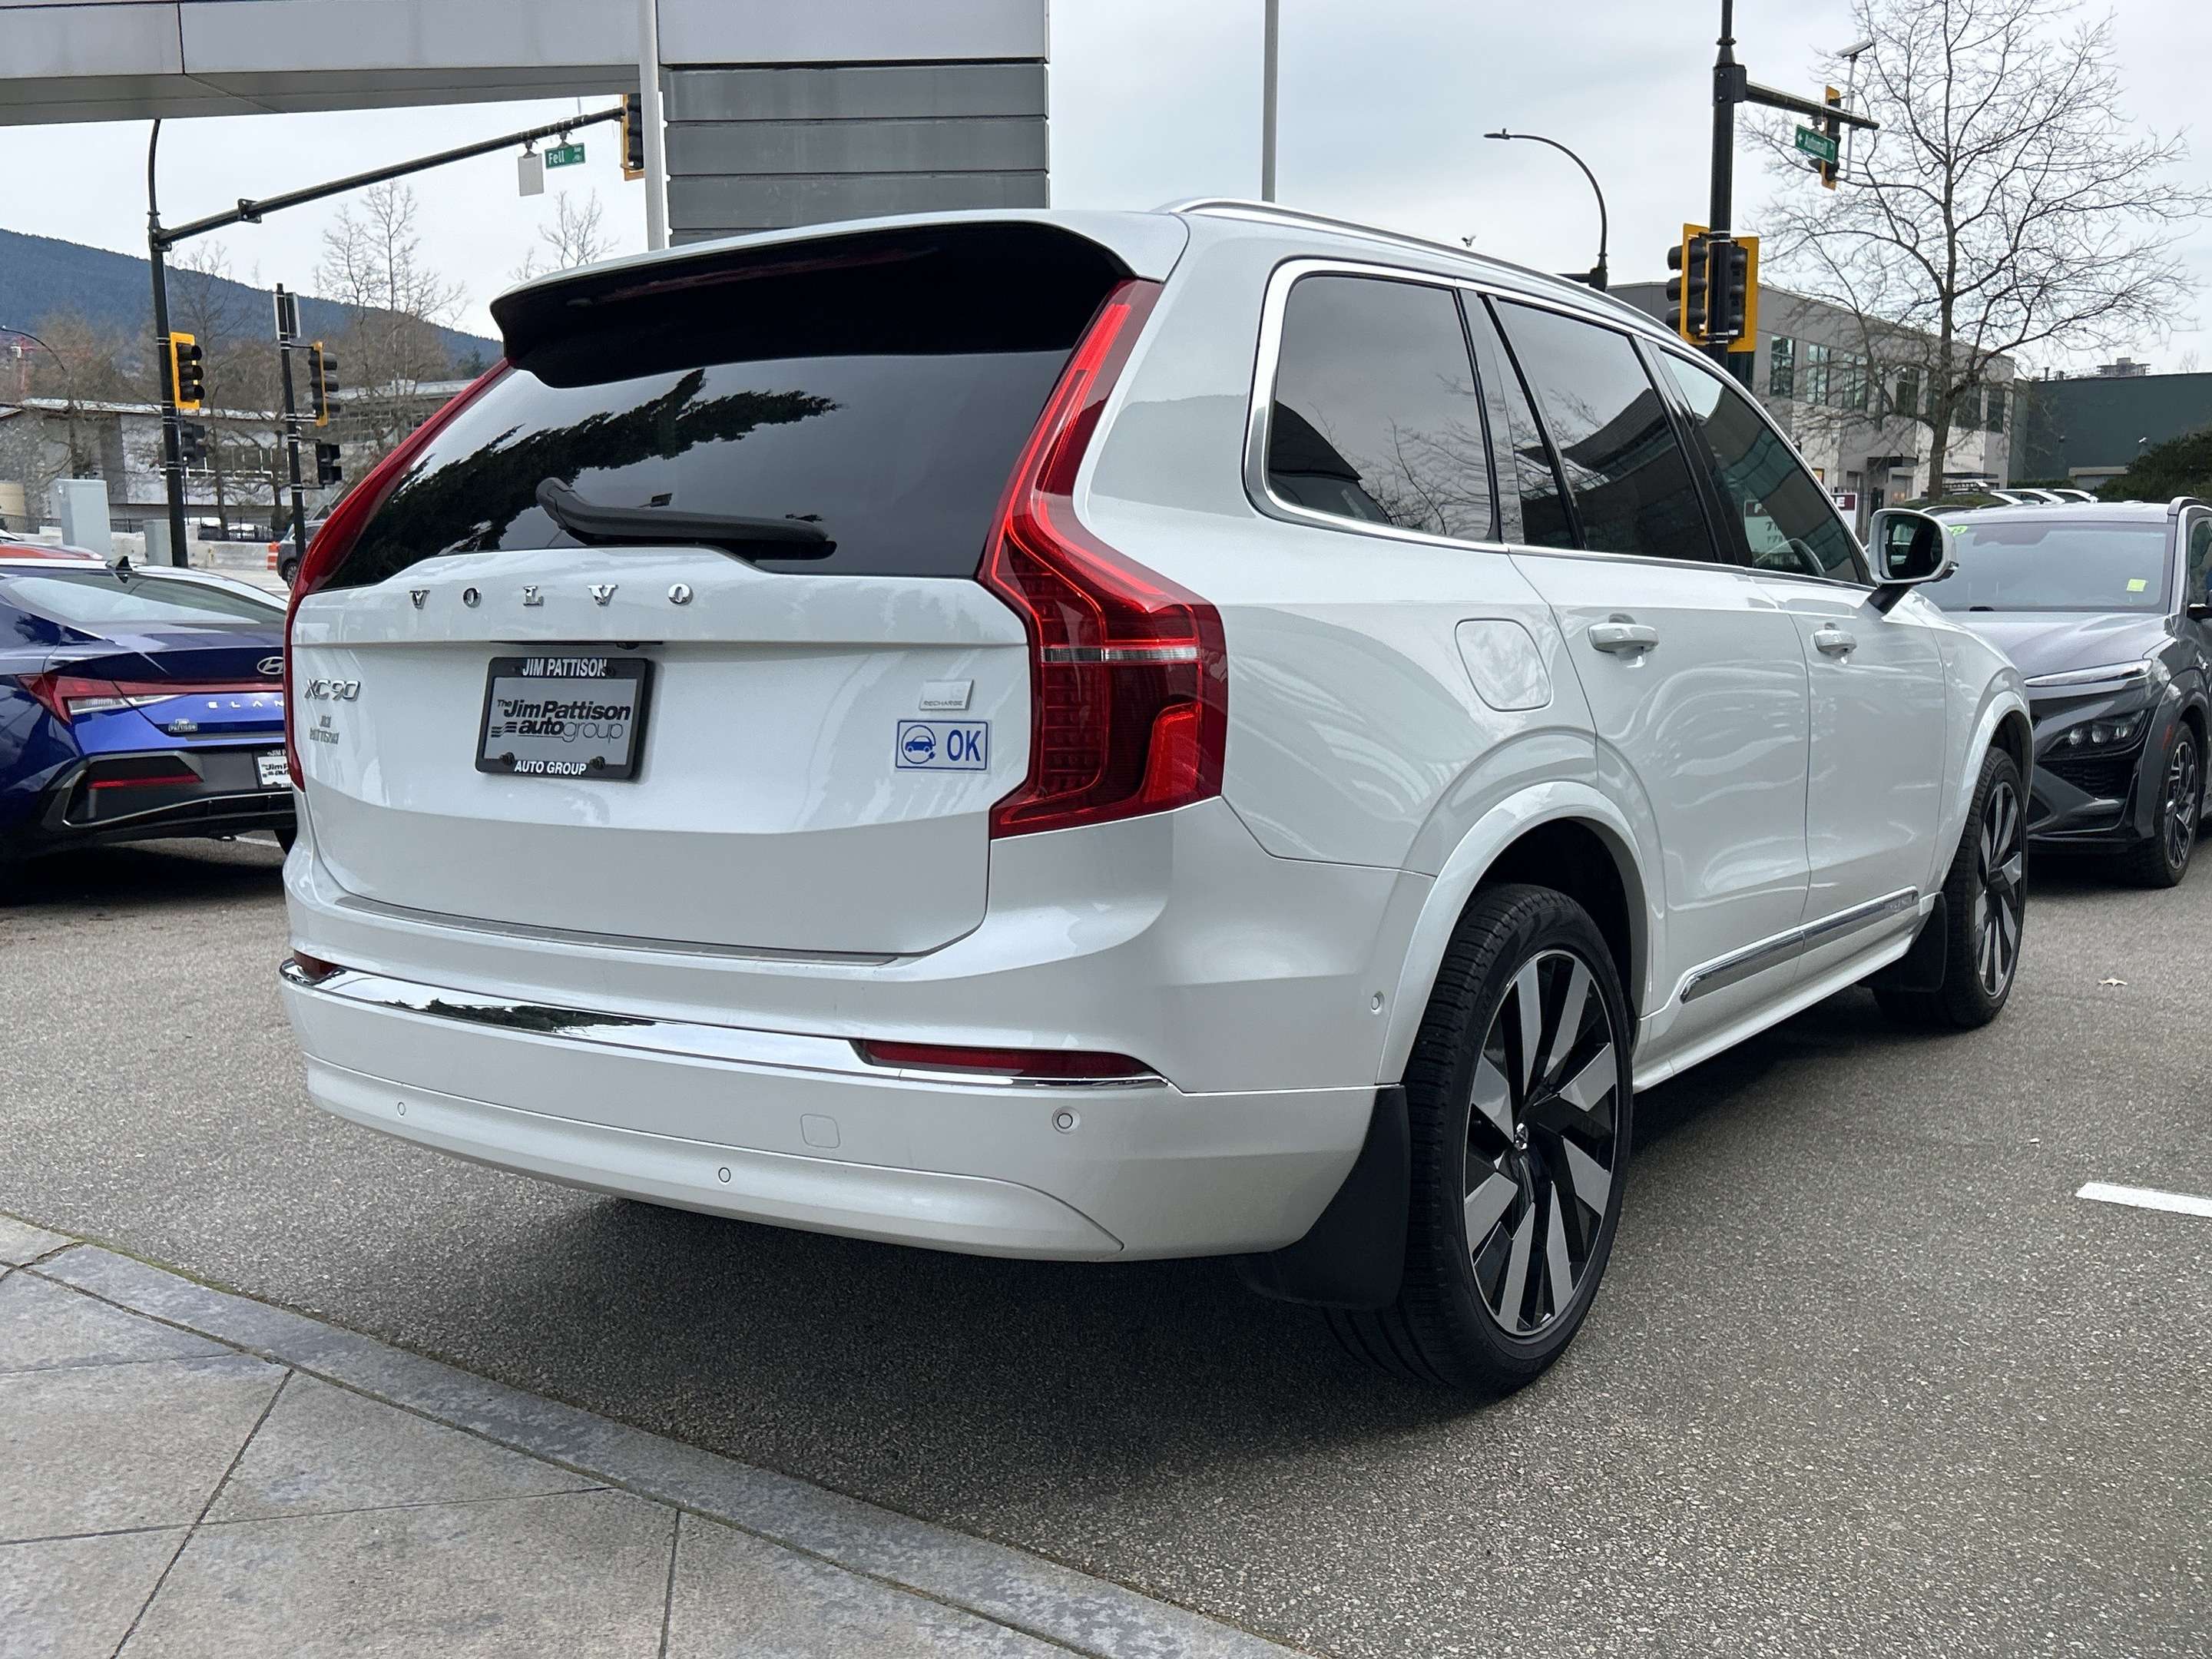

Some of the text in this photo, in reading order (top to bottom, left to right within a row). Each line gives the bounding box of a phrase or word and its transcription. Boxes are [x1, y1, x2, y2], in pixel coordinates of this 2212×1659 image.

[548, 150, 565, 165] Fell
[409, 583, 695, 609] VOLVO
[522, 658, 608, 677] JIM PATTISON
[304, 679, 361, 701] XC90
[497, 699, 512, 708] The
[947, 729, 982, 761] OK
[514, 760, 587, 775] AUTO GROUP
